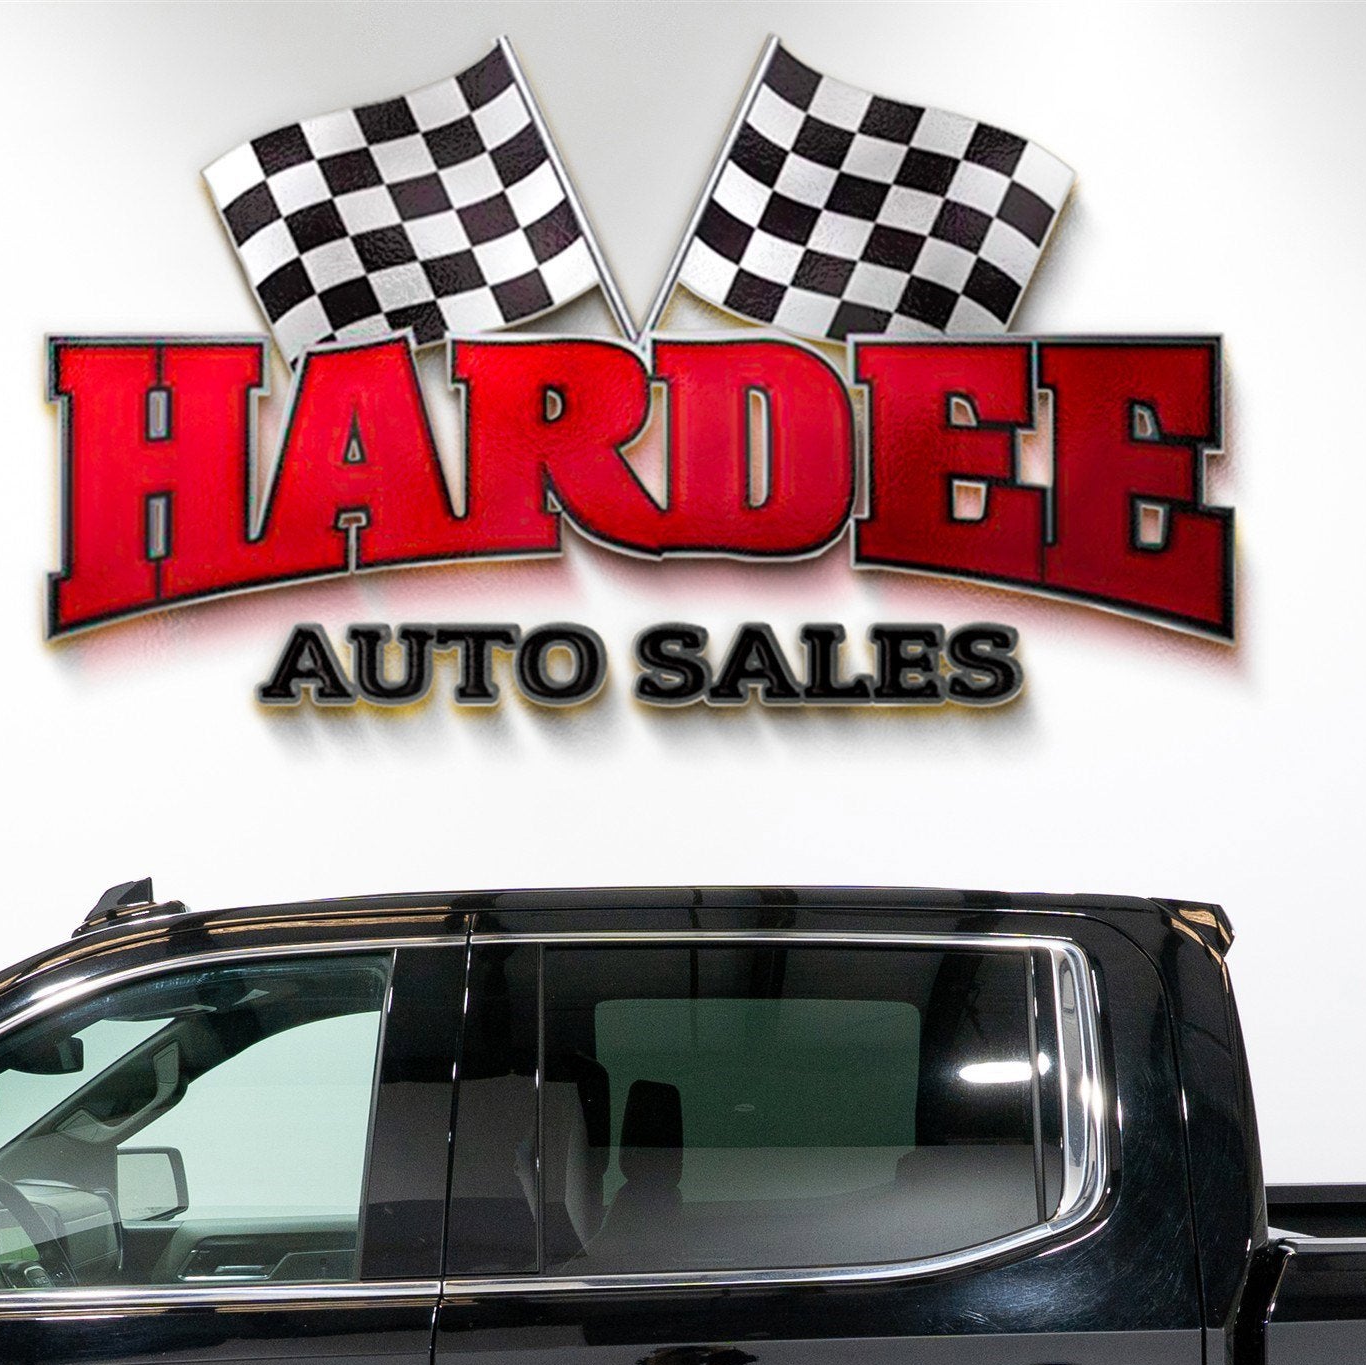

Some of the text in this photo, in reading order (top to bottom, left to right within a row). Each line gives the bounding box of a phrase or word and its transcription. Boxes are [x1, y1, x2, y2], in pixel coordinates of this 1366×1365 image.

[43, 332, 1238, 645] HARDEE
[256, 622, 1026, 708] AUTO SALES
